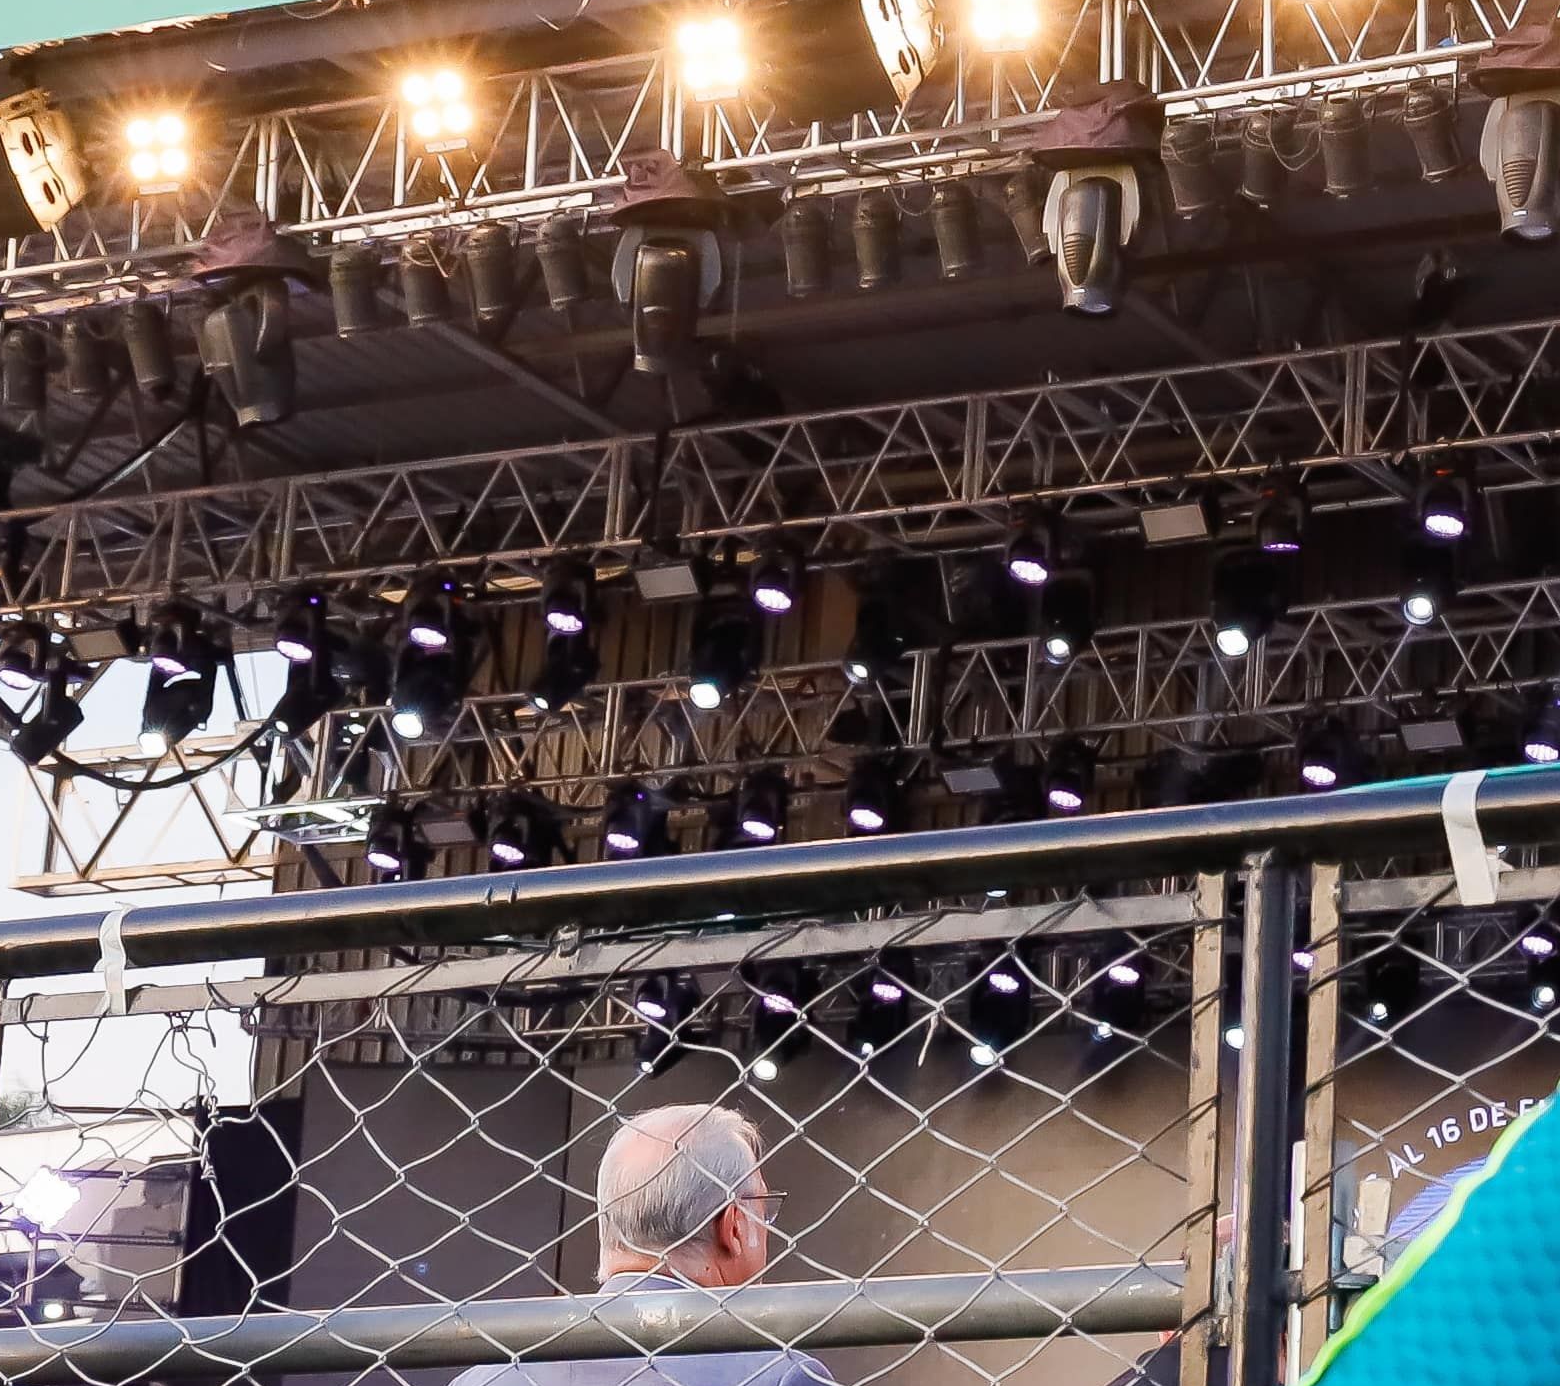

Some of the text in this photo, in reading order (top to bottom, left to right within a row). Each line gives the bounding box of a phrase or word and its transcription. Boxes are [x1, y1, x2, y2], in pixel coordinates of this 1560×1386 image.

[1388, 1143, 1425, 1179] AL
[1426, 1117, 1461, 1149] 16
[1469, 1100, 1507, 1133] DE
